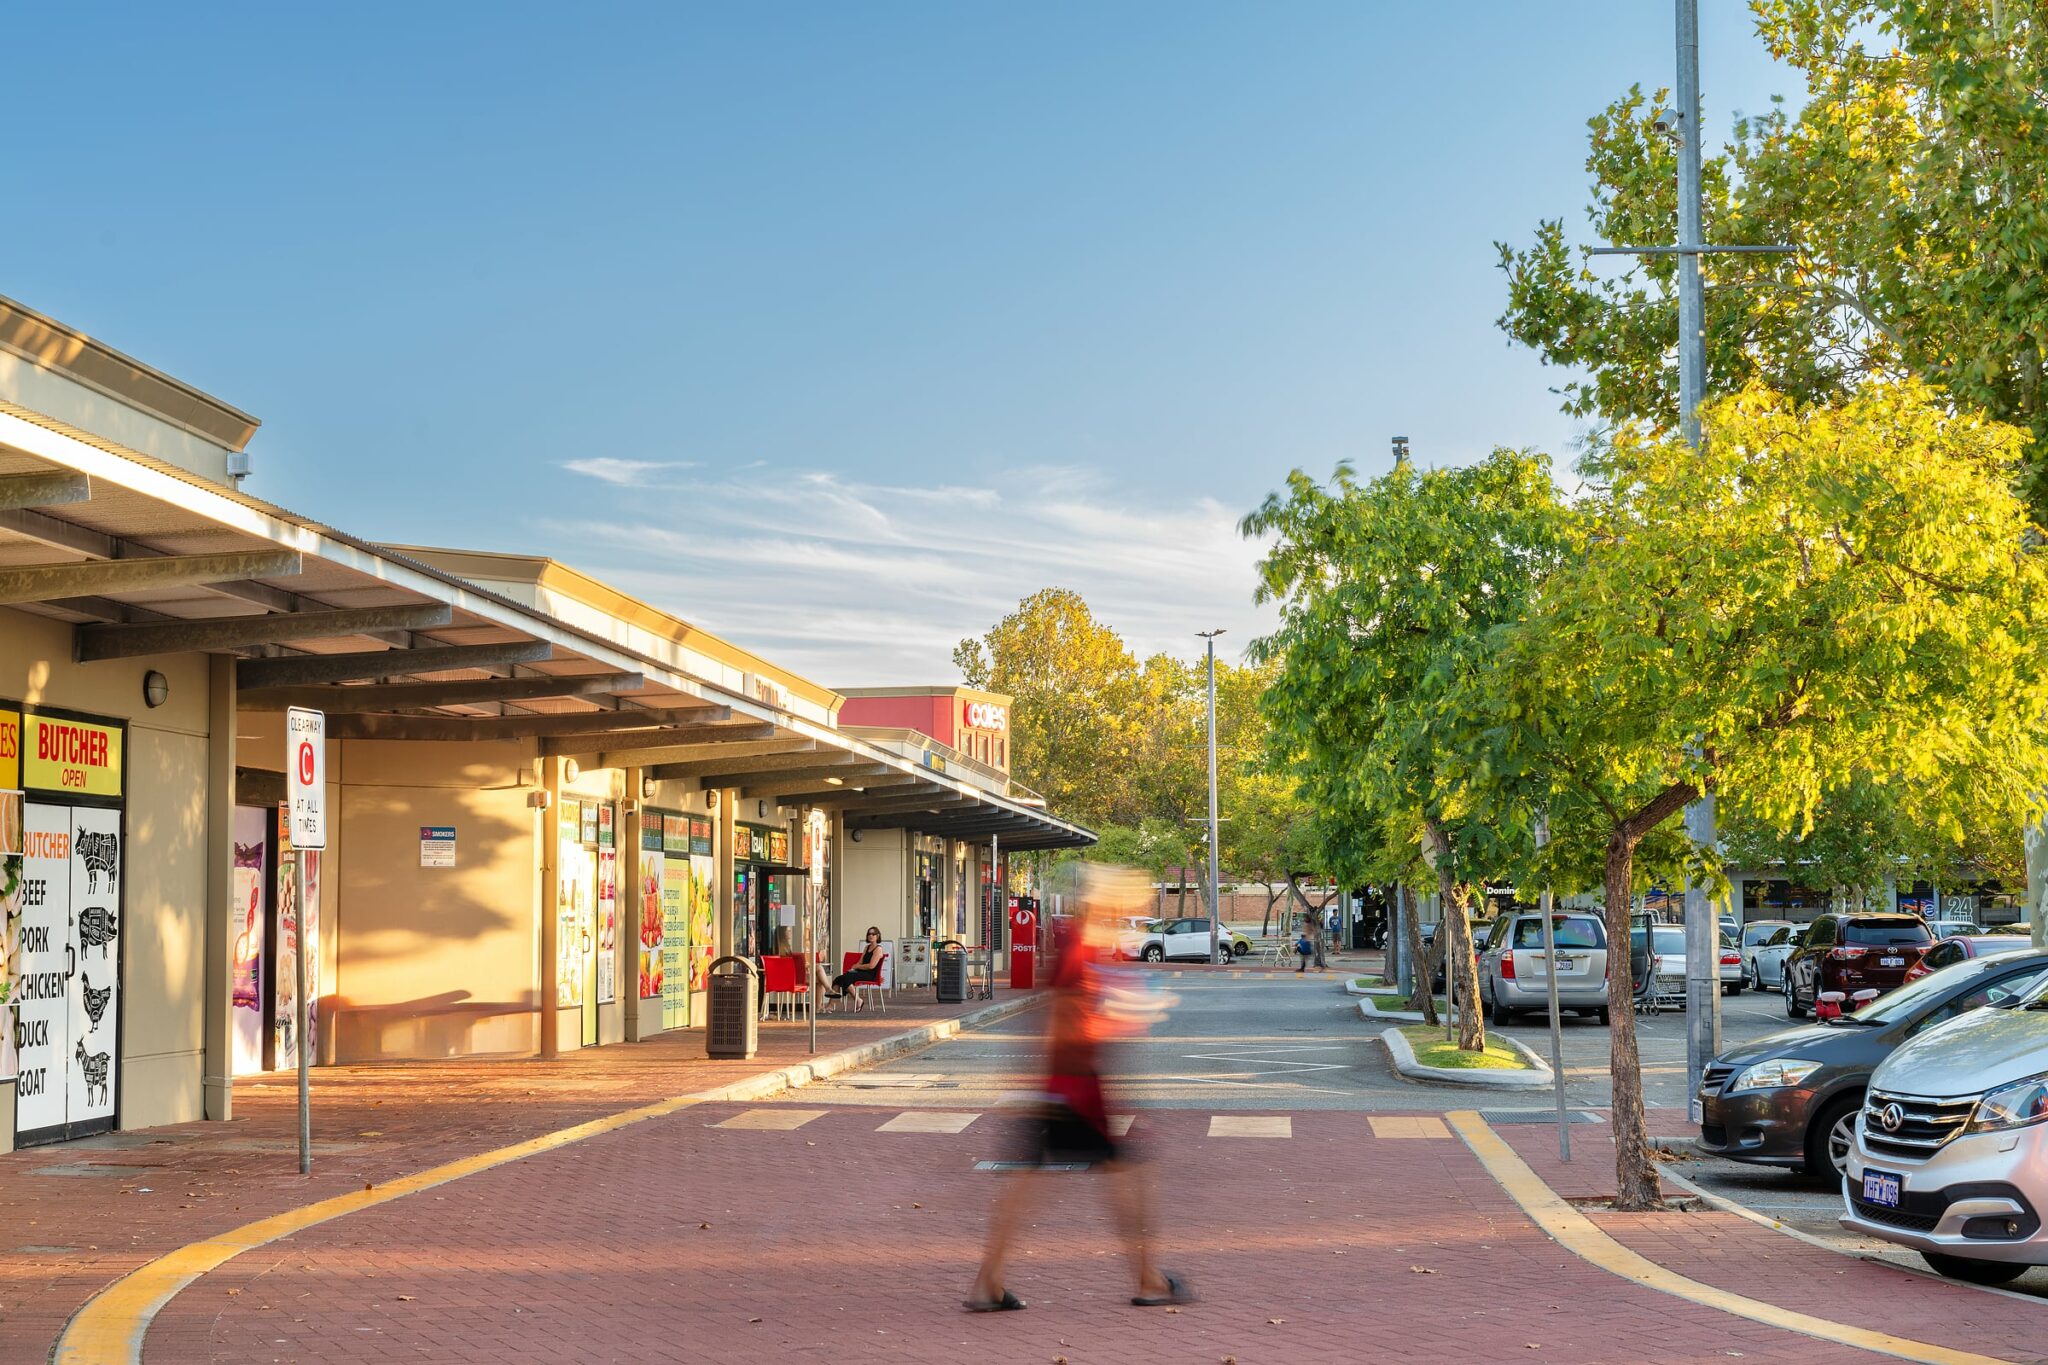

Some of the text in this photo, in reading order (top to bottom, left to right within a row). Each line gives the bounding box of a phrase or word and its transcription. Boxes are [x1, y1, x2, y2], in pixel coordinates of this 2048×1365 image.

[291, 717, 321, 735] CLEARWAY
[969, 702, 1006, 731] coles
[38, 722, 108, 768] BUTCHER
[62, 768, 87, 788] OPEN
[296, 799, 318, 814] AT ALL
[299, 819, 316, 833] TIMES
[23, 831, 69, 859] BUTCHER
[1948, 896, 1973, 918] 24
[21, 926, 49, 953] PORK
[20, 972, 65, 1000] CHICKEN
[19, 1020, 49, 1049] DUCK
[19, 1067, 46, 1097] GOAT
